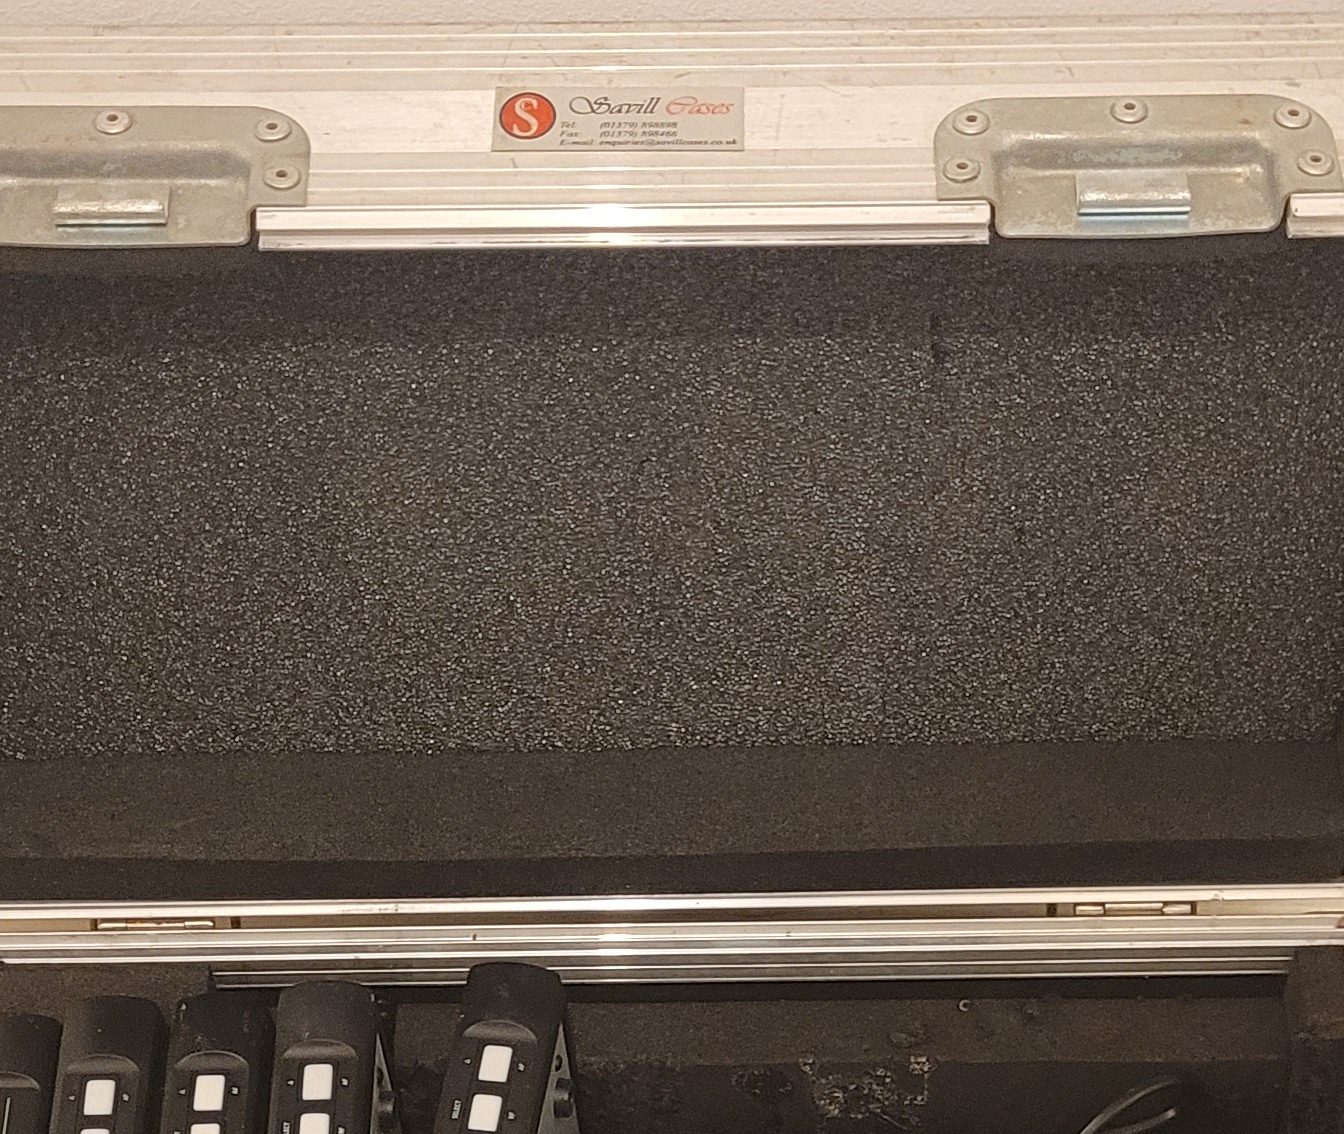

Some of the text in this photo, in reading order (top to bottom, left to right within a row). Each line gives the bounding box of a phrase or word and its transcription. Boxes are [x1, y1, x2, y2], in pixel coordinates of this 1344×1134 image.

[569, 96, 734, 115] Savill Cases
[599, 121, 638, 129] (01379)
[451, 1099, 461, 1119] SELECT
